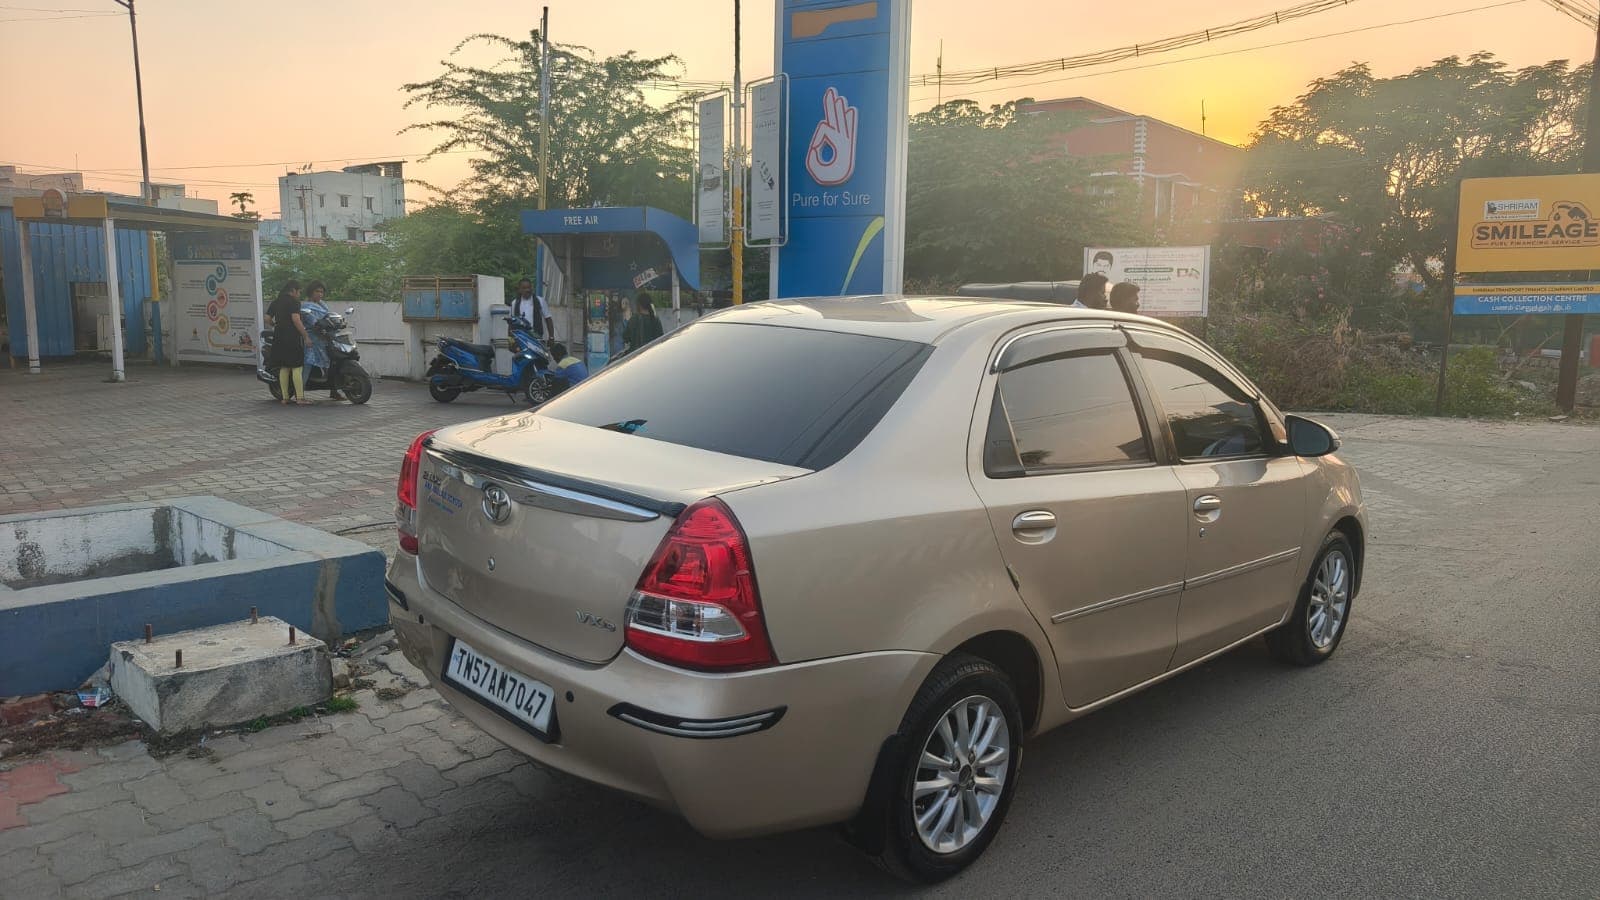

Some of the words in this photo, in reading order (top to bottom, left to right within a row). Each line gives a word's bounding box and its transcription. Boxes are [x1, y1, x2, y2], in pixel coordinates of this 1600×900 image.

[792, 193, 819, 207] Pure
[823, 192, 839, 206] for
[842, 191, 871, 205] Sure
[1497, 202, 1538, 210] SHRIRAM
[563, 216, 583, 226] FREE
[584, 215, 599, 225] AIR
[1476, 222, 1599, 240] SMILEAGE
[1478, 295, 1500, 303] CASH
[456, 648, 547, 719] TN57AM7047
